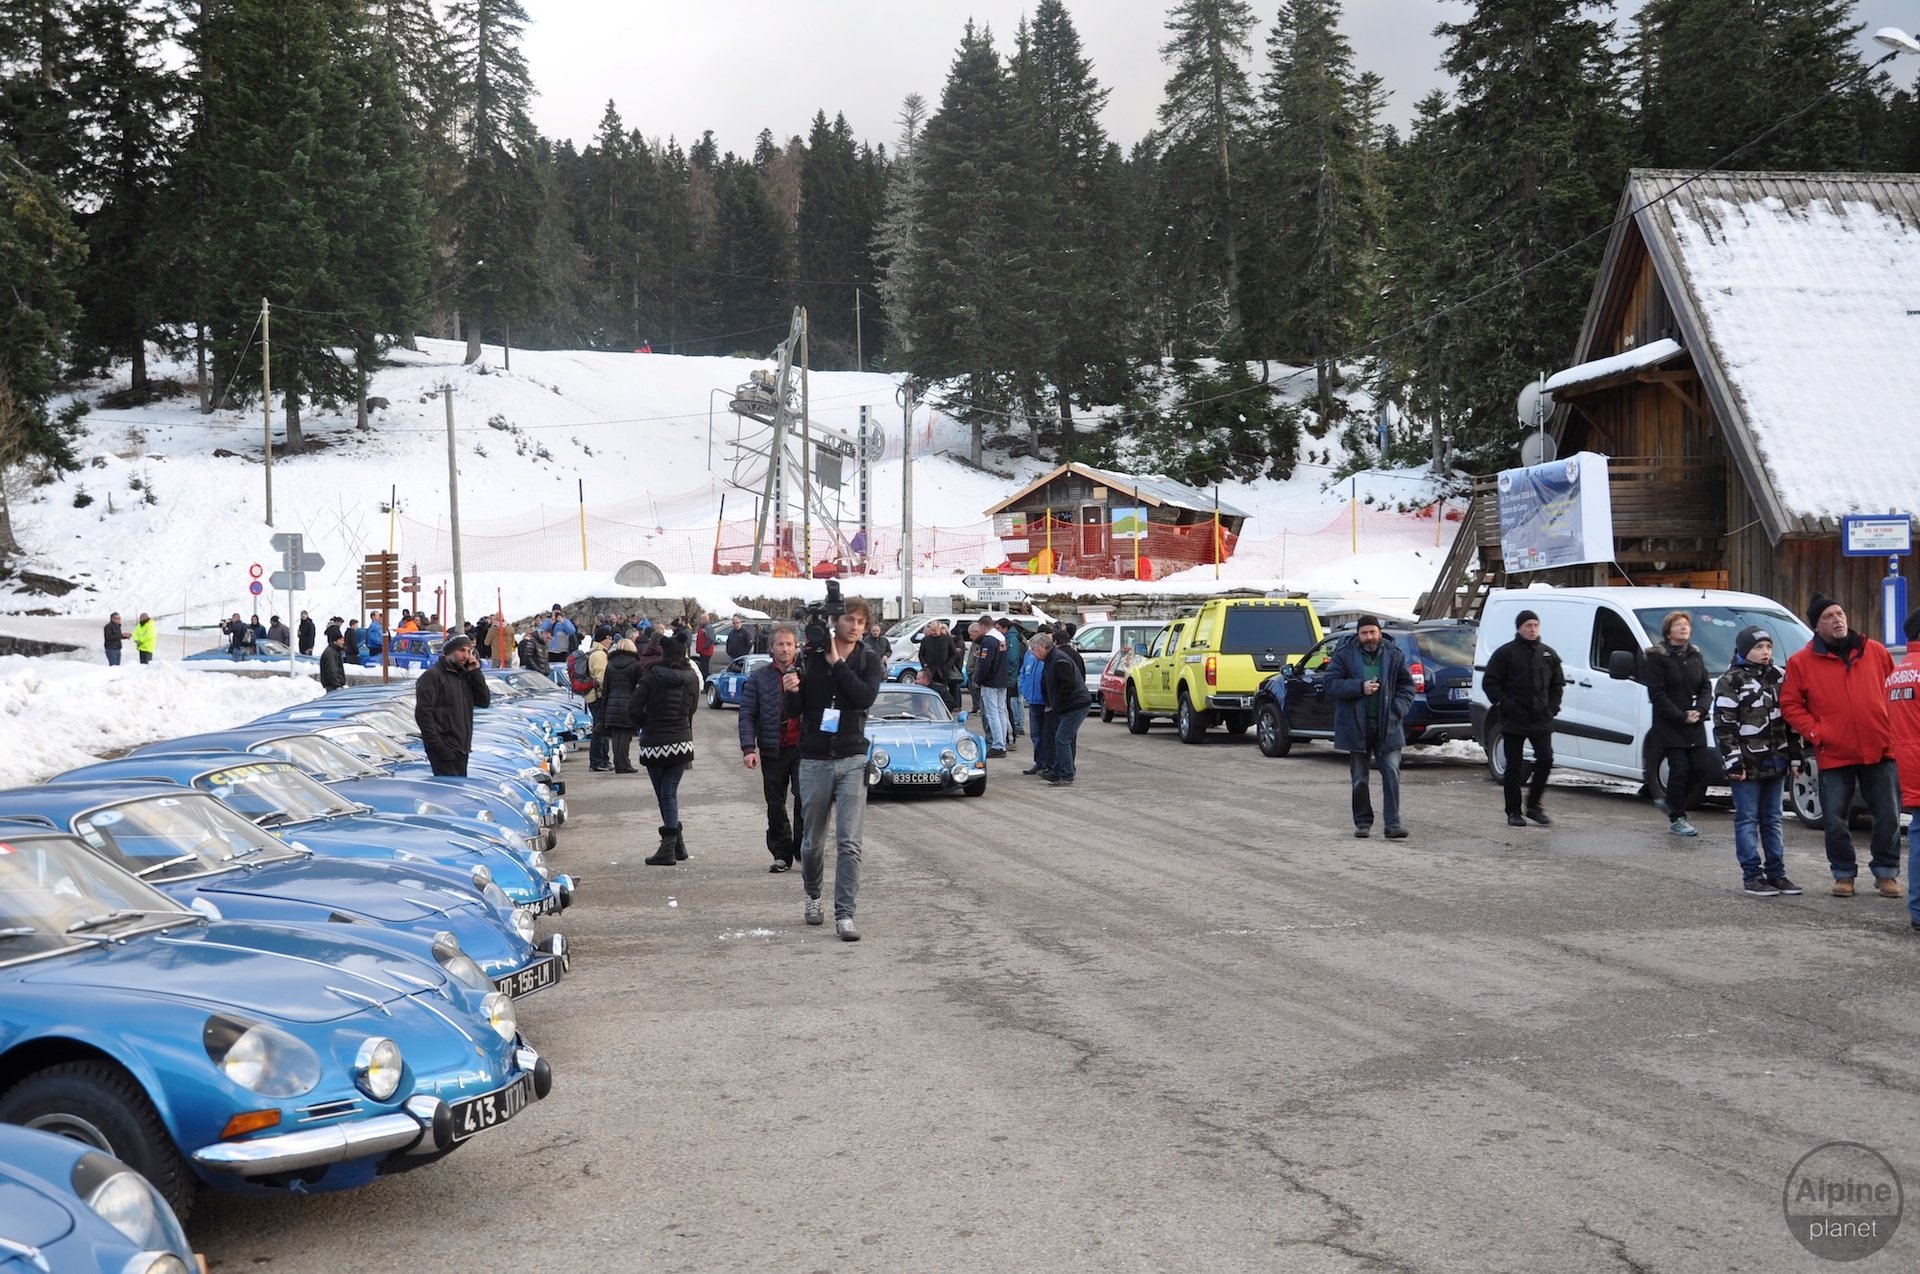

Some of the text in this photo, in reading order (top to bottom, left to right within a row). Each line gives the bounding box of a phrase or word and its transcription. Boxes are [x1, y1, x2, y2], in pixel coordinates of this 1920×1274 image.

[894, 773, 940, 783] 839 CCR 06
[464, 1095, 497, 1131] 413
